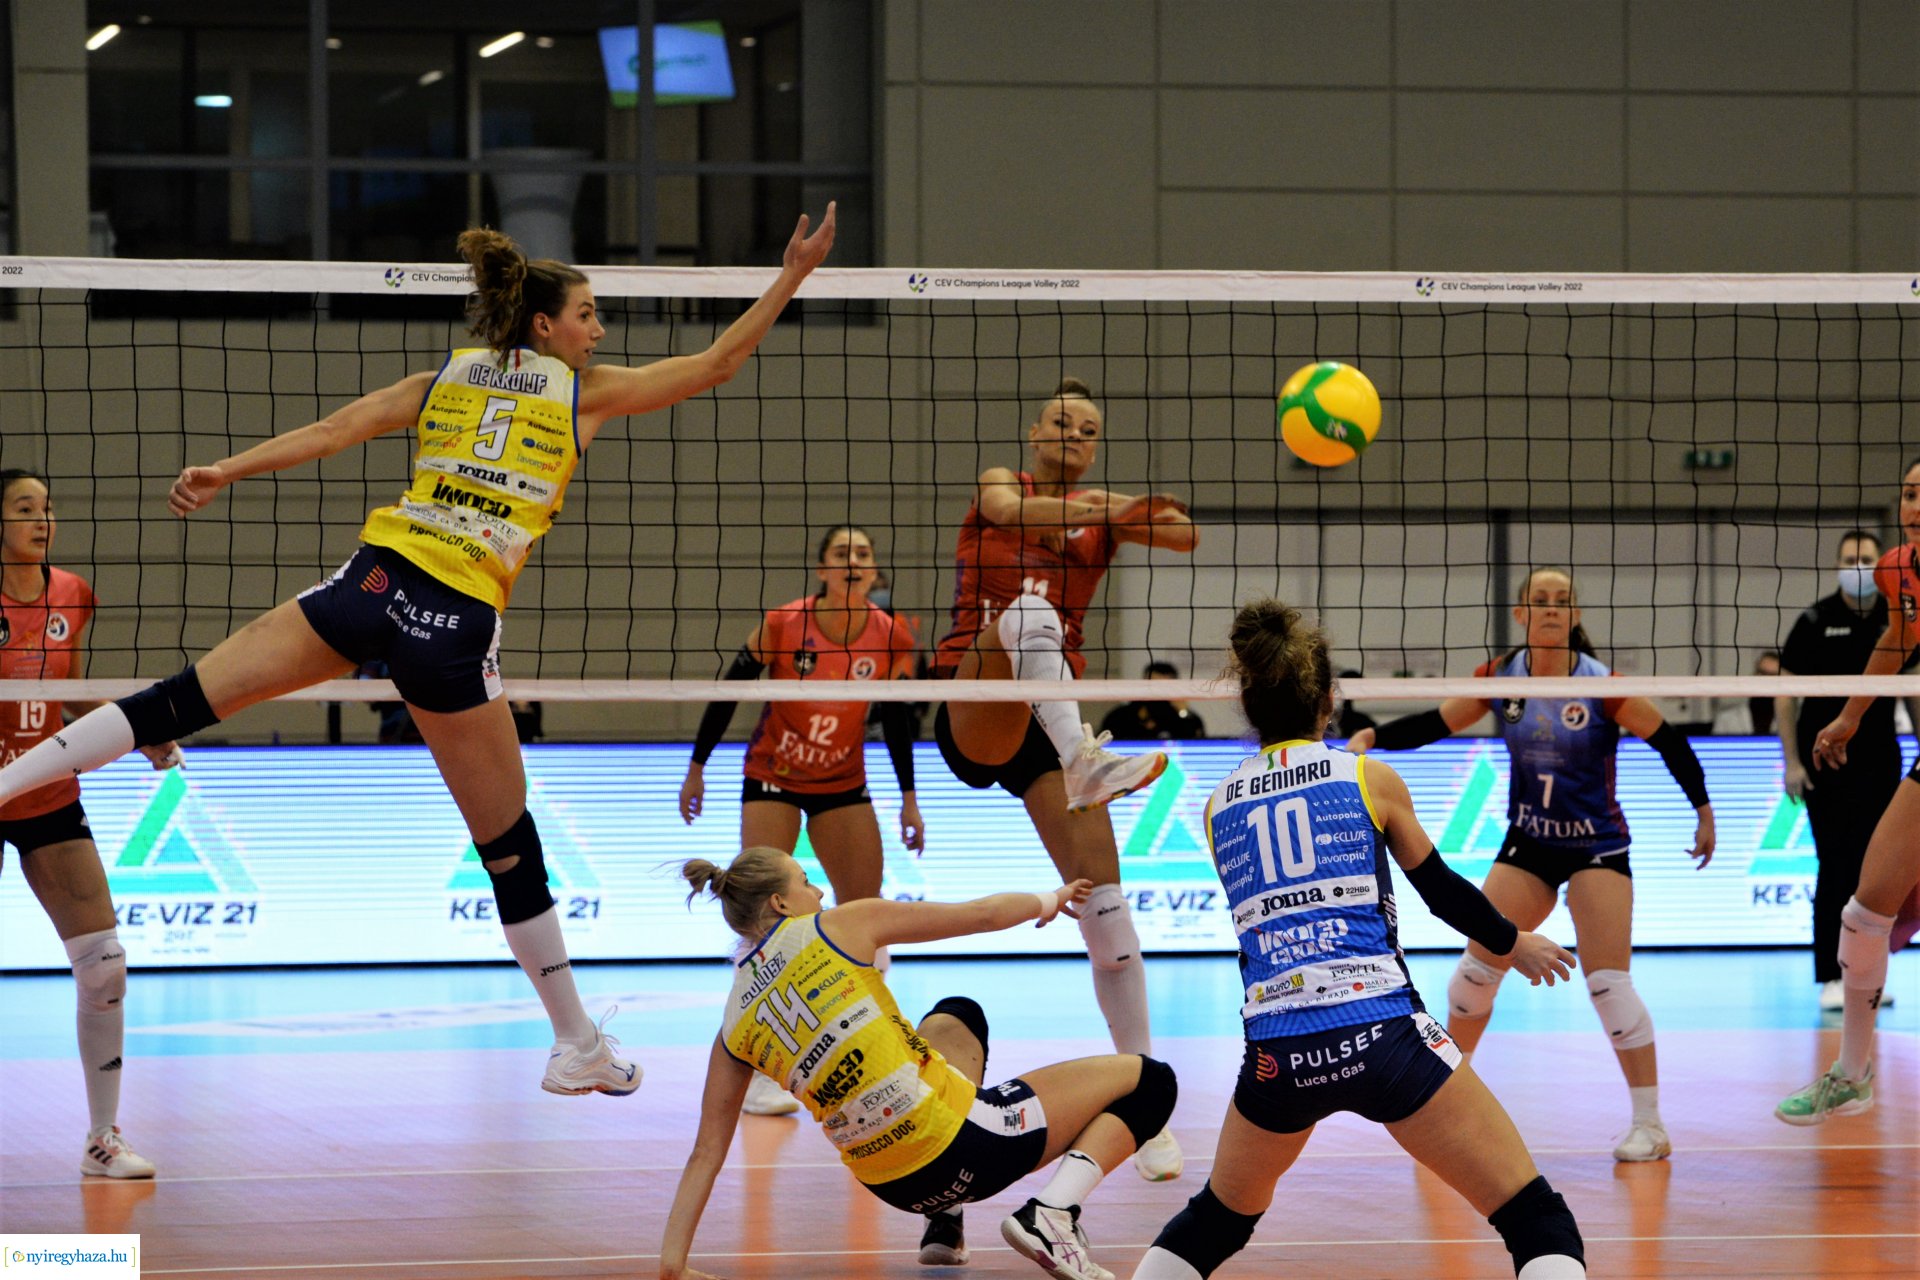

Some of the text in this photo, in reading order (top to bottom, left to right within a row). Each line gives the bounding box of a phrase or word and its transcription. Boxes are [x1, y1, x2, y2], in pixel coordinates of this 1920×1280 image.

[2, 265, 23, 275] 2022
[411, 273, 430, 282] CEV
[935, 279, 1080, 288] CEV Champions League Volley 2022
[1441, 282, 1583, 292] CEV Champions League Volley 2022
[469, 363, 547, 395] DE KRUIJF
[430, 403, 468, 416] Autopolar
[472, 395, 518, 462] 5
[527, 420, 567, 437] Autopolar
[462, 539, 487, 563] DOC
[410, 626, 432, 641] Gas
[18, 700, 47, 730] 15
[807, 713, 840, 746] 12
[1226, 759, 1332, 804] DE GENNARO
[1537, 773, 1554, 810] 7
[1311, 797, 1361, 808] VOLVO
[1314, 811, 1363, 823] Autopolar
[1515, 802, 1597, 838] FATUM
[1246, 796, 1317, 885] 10
[1332, 829, 1368, 843] ECLISSE
[1345, 885, 1371, 896] 22HBG
[222, 901, 257, 925] 21
[566, 896, 601, 919] 21
[797, 958, 832, 987] Autopolar
[1265, 979, 1291, 995] MORO
[755, 981, 821, 1056] 14
[1290, 1023, 1385, 1070] PULSEE
[1294, 1060, 1366, 1089] Luce e Gas
[846, 1134, 895, 1160] PROSECCO
[890, 1119, 917, 1141] DOC
[911, 1167, 976, 1213] PULSEE
